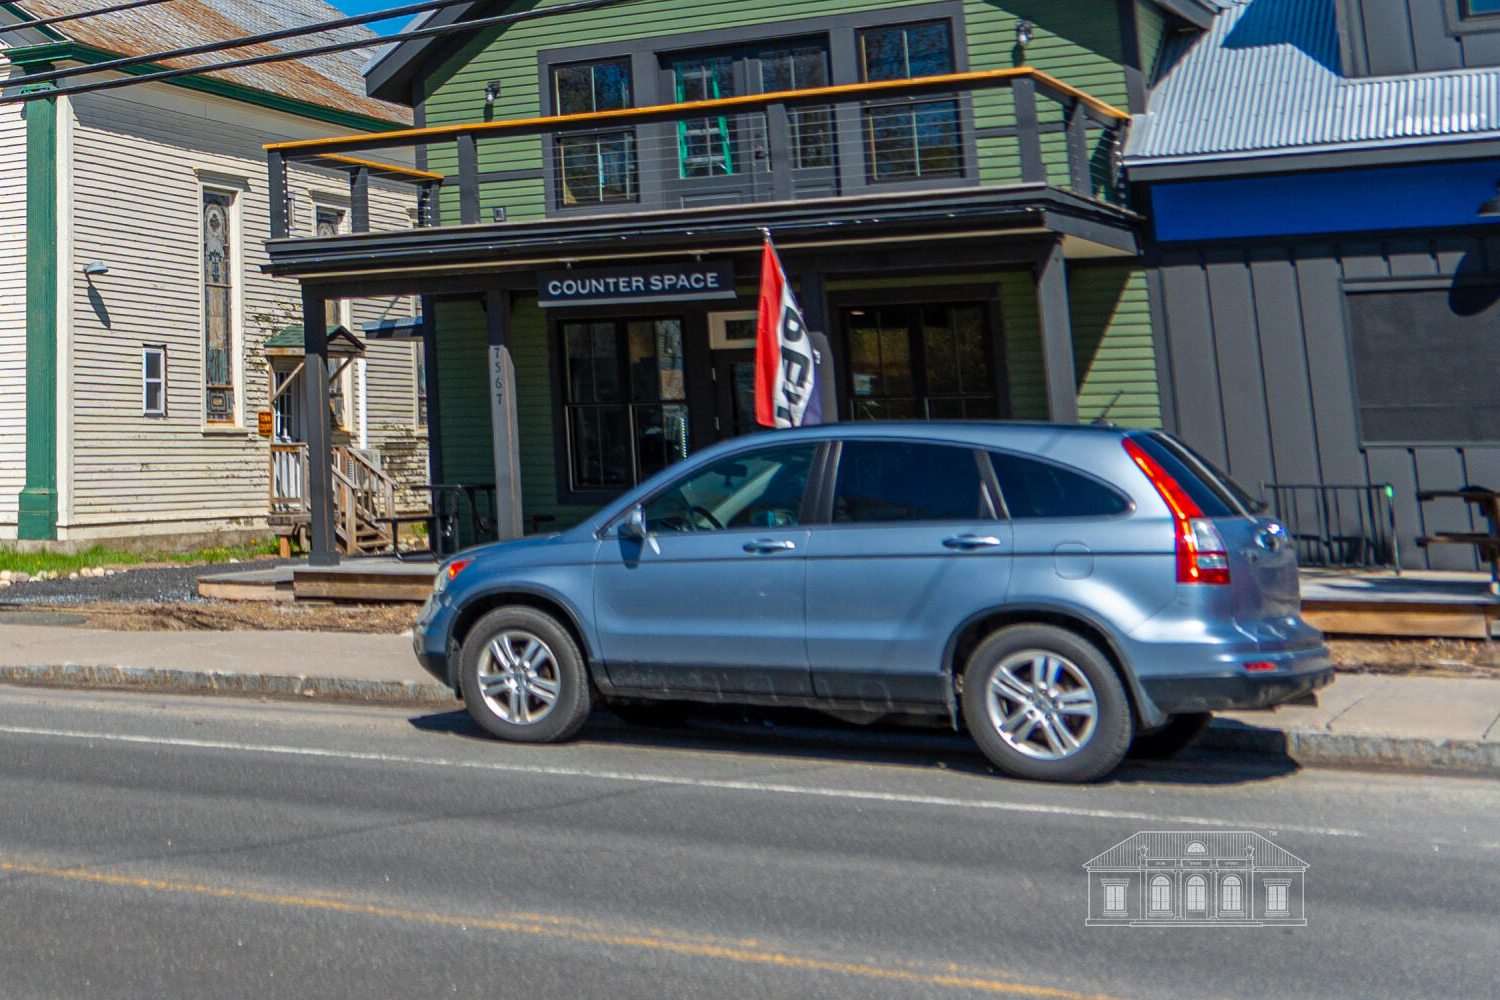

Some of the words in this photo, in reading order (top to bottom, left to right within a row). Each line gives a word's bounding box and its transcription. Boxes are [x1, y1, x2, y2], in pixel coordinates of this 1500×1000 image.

[548, 276, 645, 296] COUNTER
[649, 272, 720, 291] SPACE
[493, 347, 503, 405] 7567
